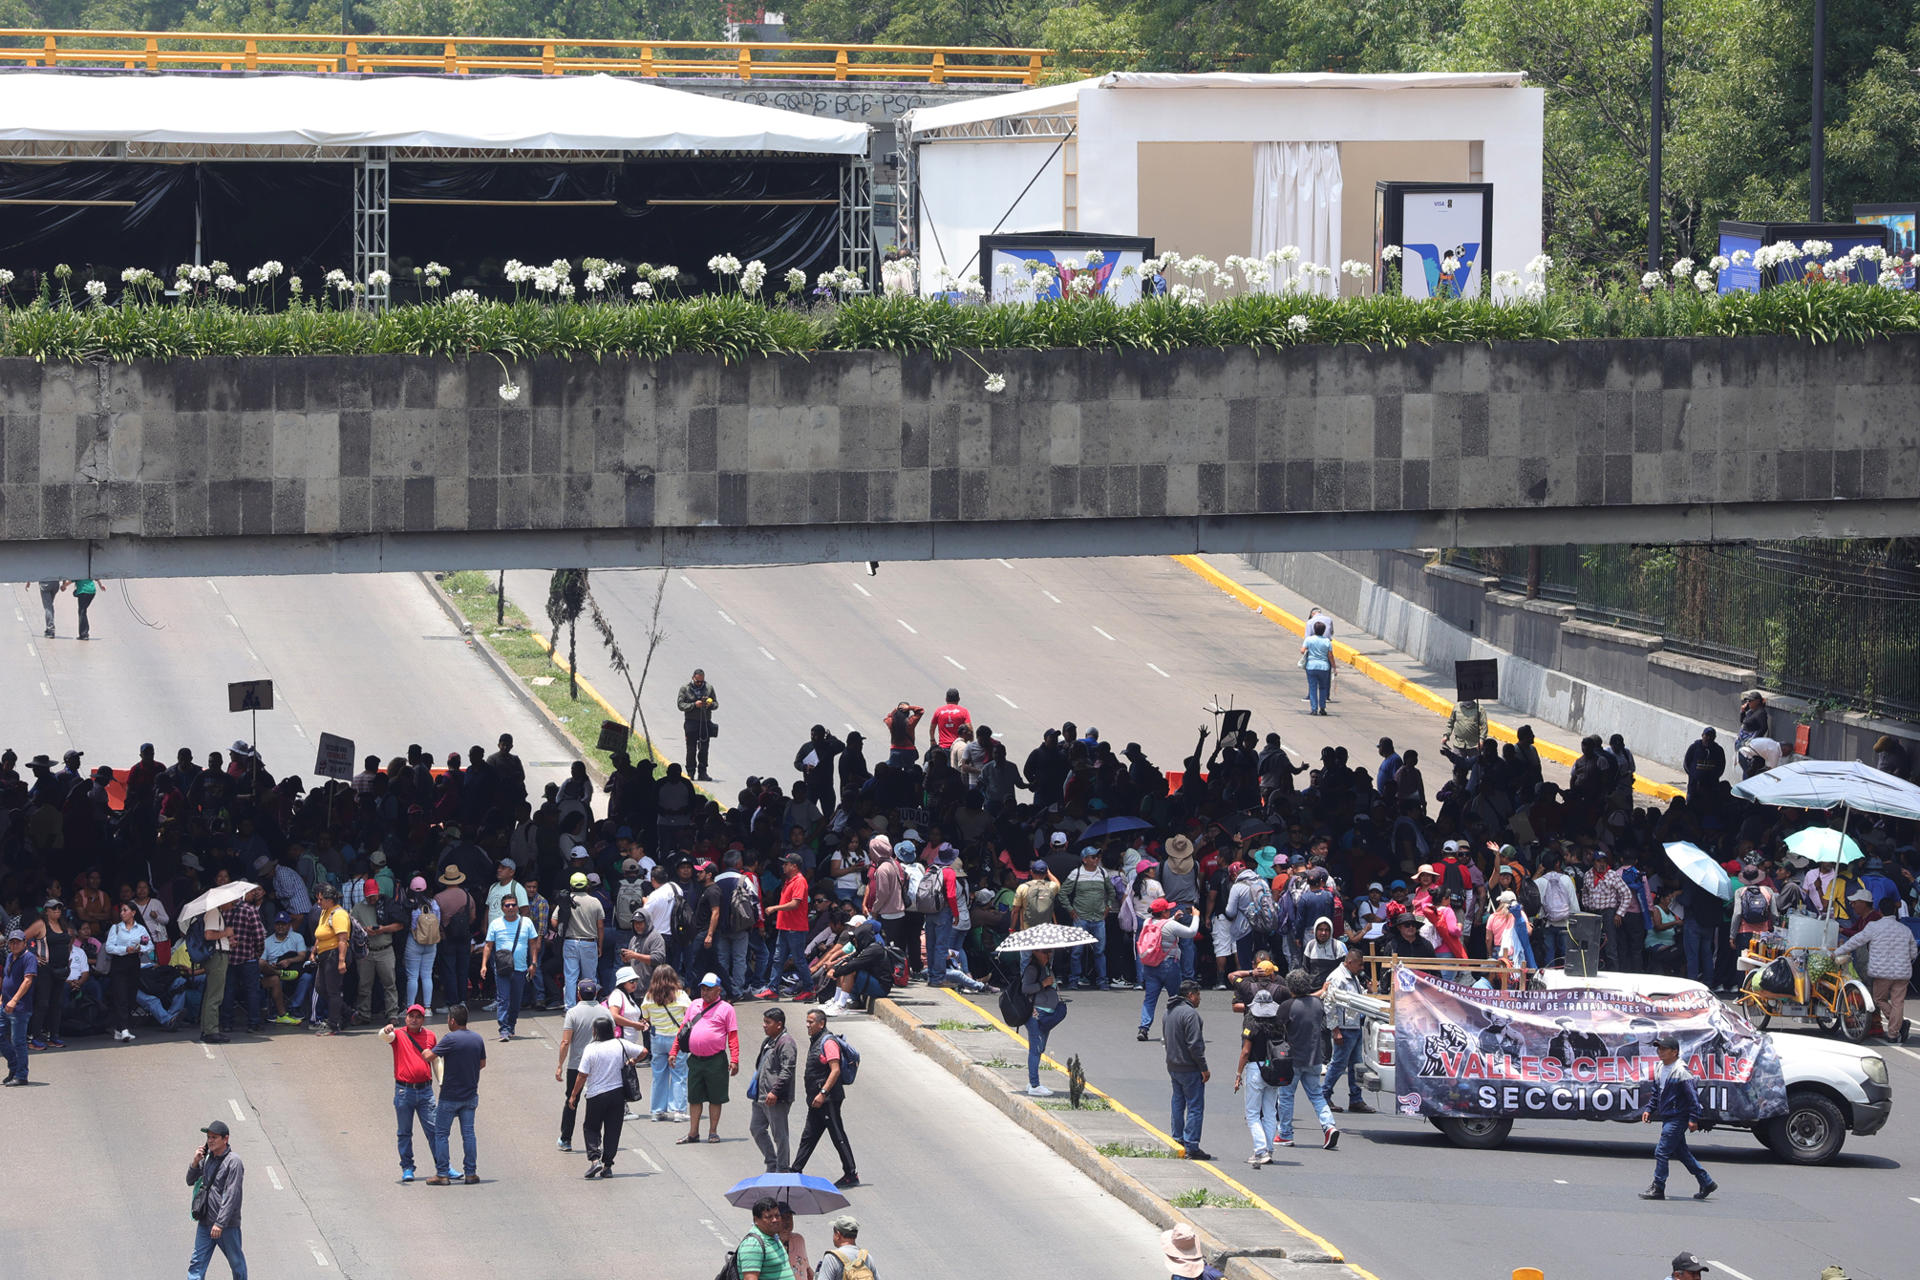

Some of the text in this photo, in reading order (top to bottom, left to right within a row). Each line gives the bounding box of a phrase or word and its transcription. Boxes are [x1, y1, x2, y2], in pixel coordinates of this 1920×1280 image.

[1424, 976, 1501, 997] COORDINADORA
[1509, 990, 1559, 1000] NACIONAL
[1567, 991, 1579, 1000] DE
[1492, 999, 1542, 1011] NACIONAL
[1546, 1002, 1559, 1011] DE
[1563, 1002, 1640, 1013] TRABAJADORES
[1440, 1051, 1754, 1083] VALLES CENTALES
[1478, 1084, 1639, 1112] SECCIÓN
